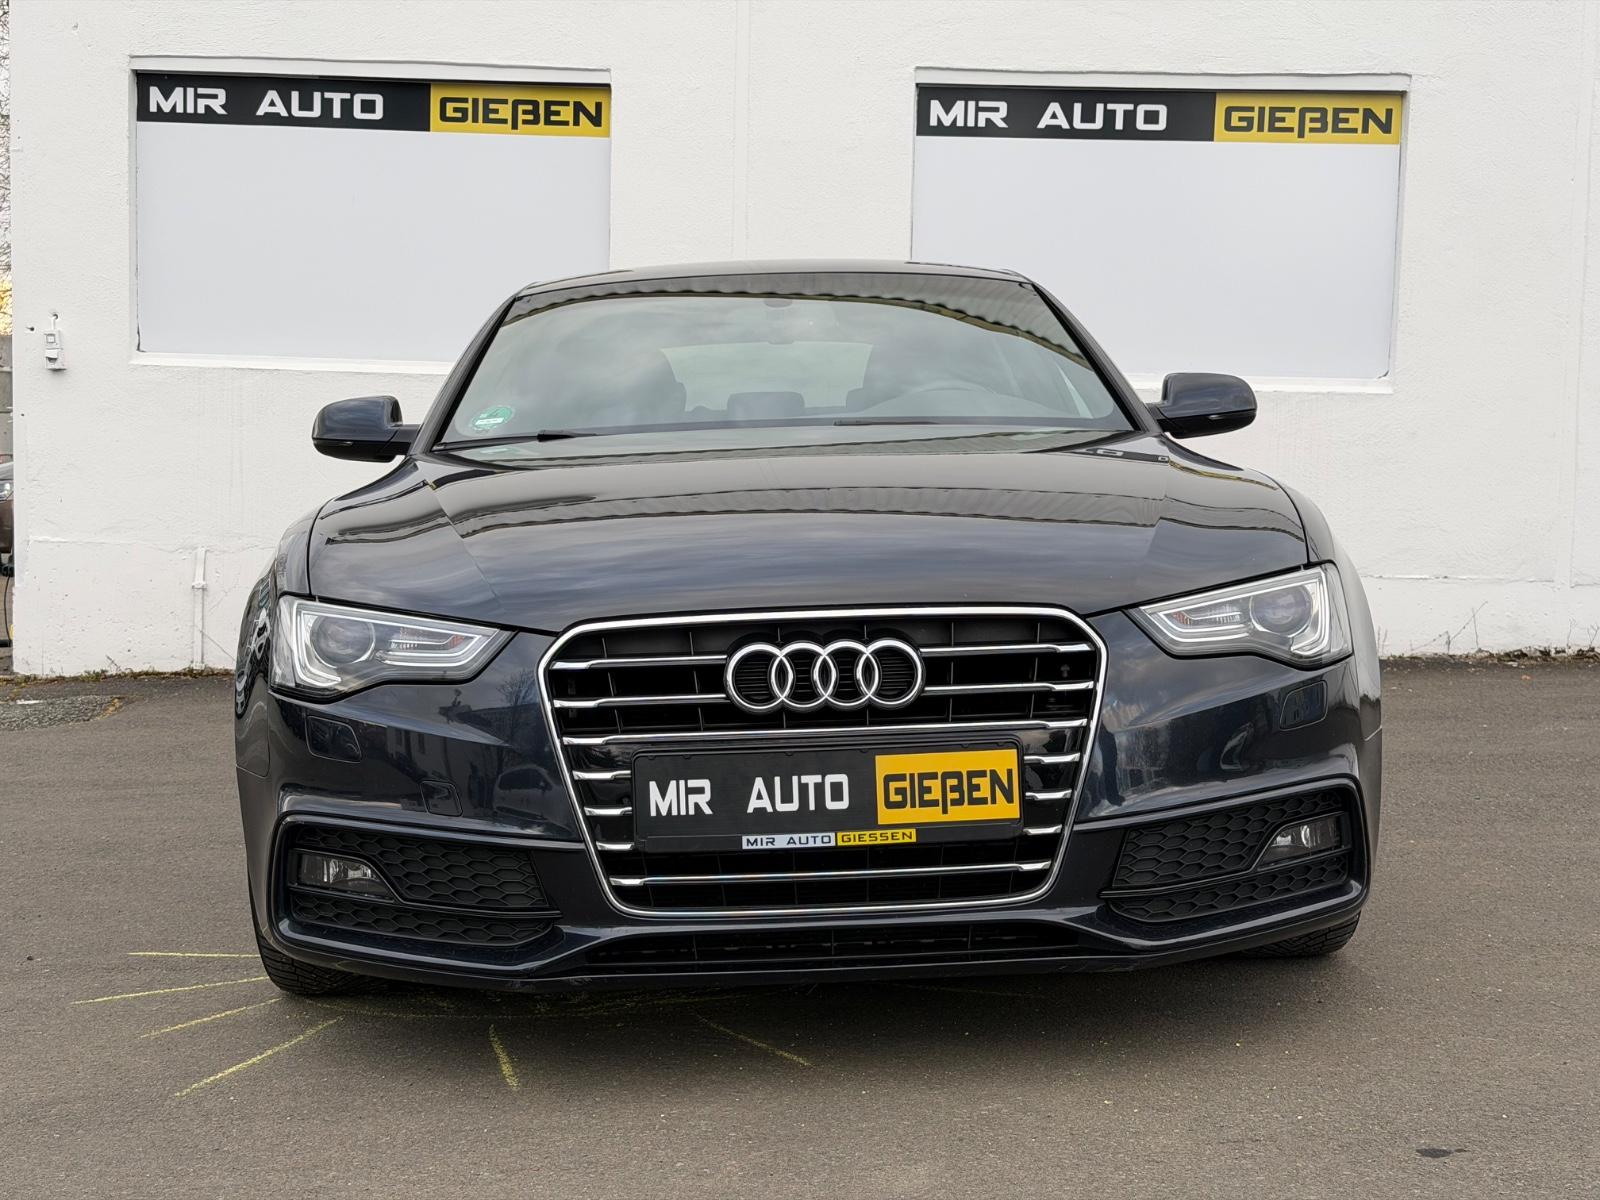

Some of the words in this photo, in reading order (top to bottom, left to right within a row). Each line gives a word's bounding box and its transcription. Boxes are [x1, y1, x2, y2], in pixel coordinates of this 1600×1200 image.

[149, 85, 228, 115] MIR
[255, 89, 384, 120] AUTO
[929, 99, 1008, 129] MIR
[1037, 102, 1168, 131] AUTO
[649, 778, 713, 817] MIR
[746, 773, 849, 814] AUTO
[746, 837, 776, 847] MIR
[786, 835, 831, 846] AUTO
[841, 831, 913, 843] GIESSEN
